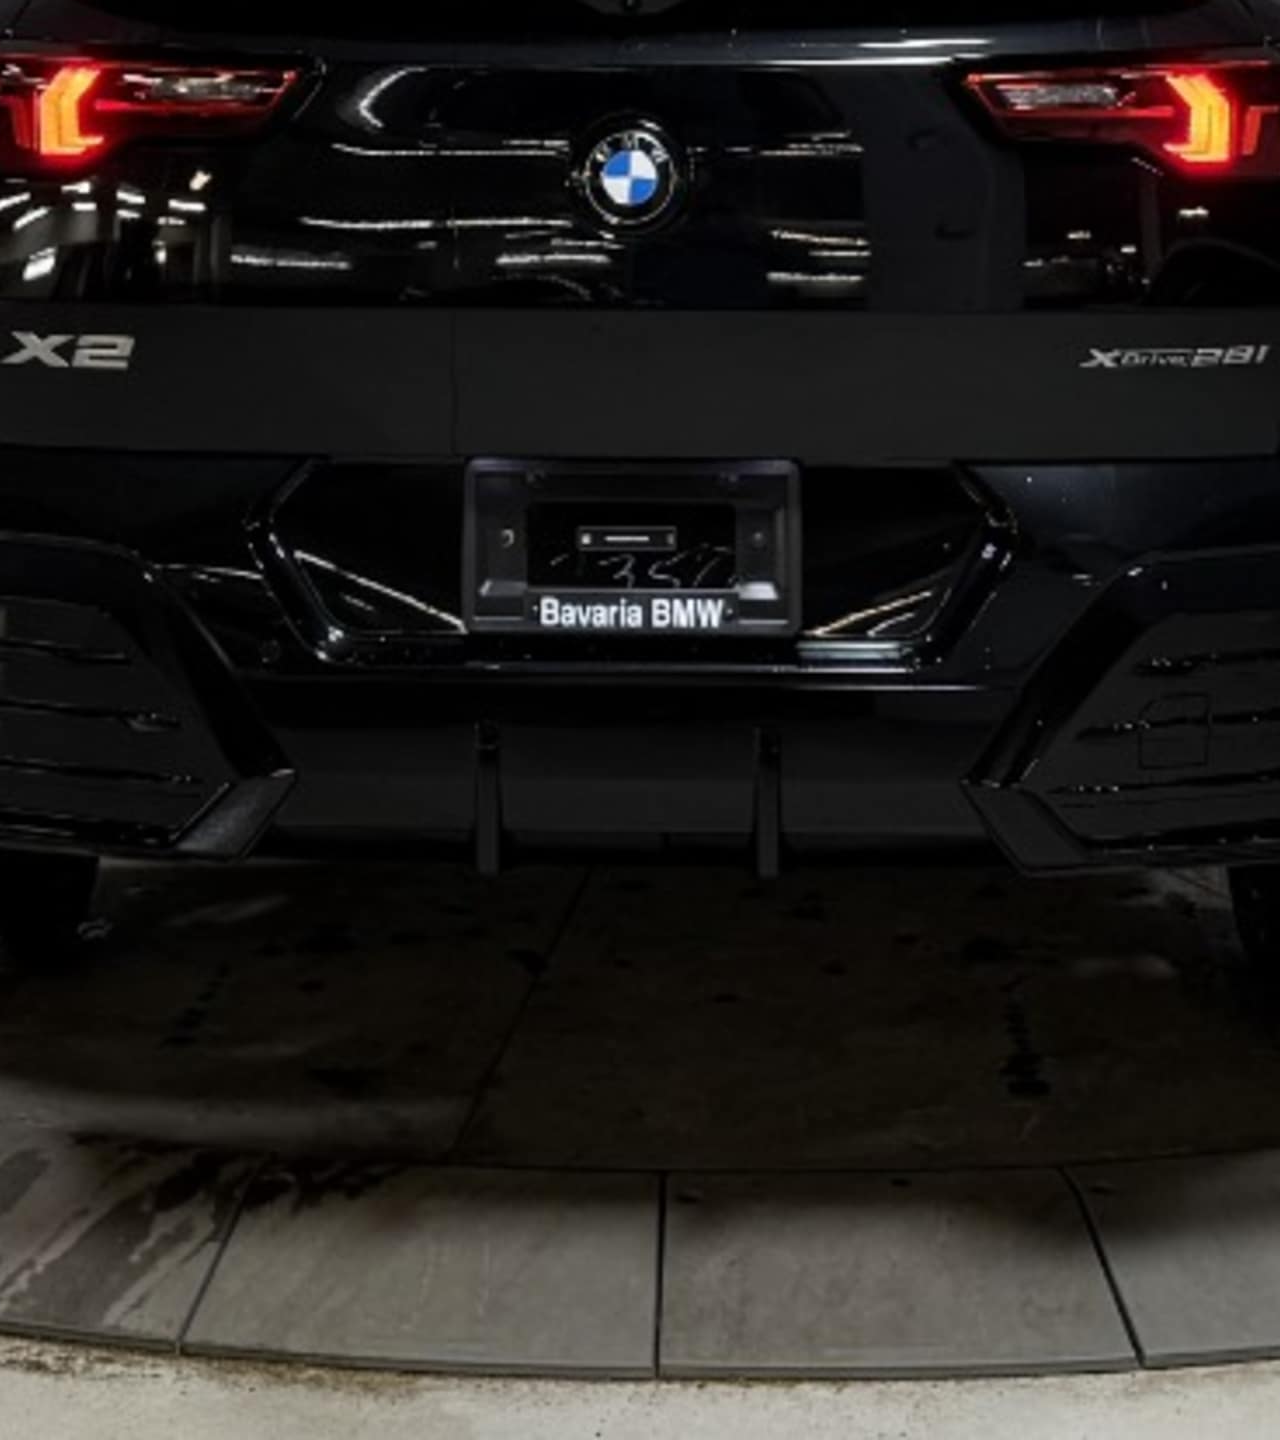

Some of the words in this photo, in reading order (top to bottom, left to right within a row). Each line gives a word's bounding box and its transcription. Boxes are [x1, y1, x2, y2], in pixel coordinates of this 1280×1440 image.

[0, 331, 136, 369] X2
[539, 596, 644, 628] Bavaria
[651, 598, 725, 628] BMW
